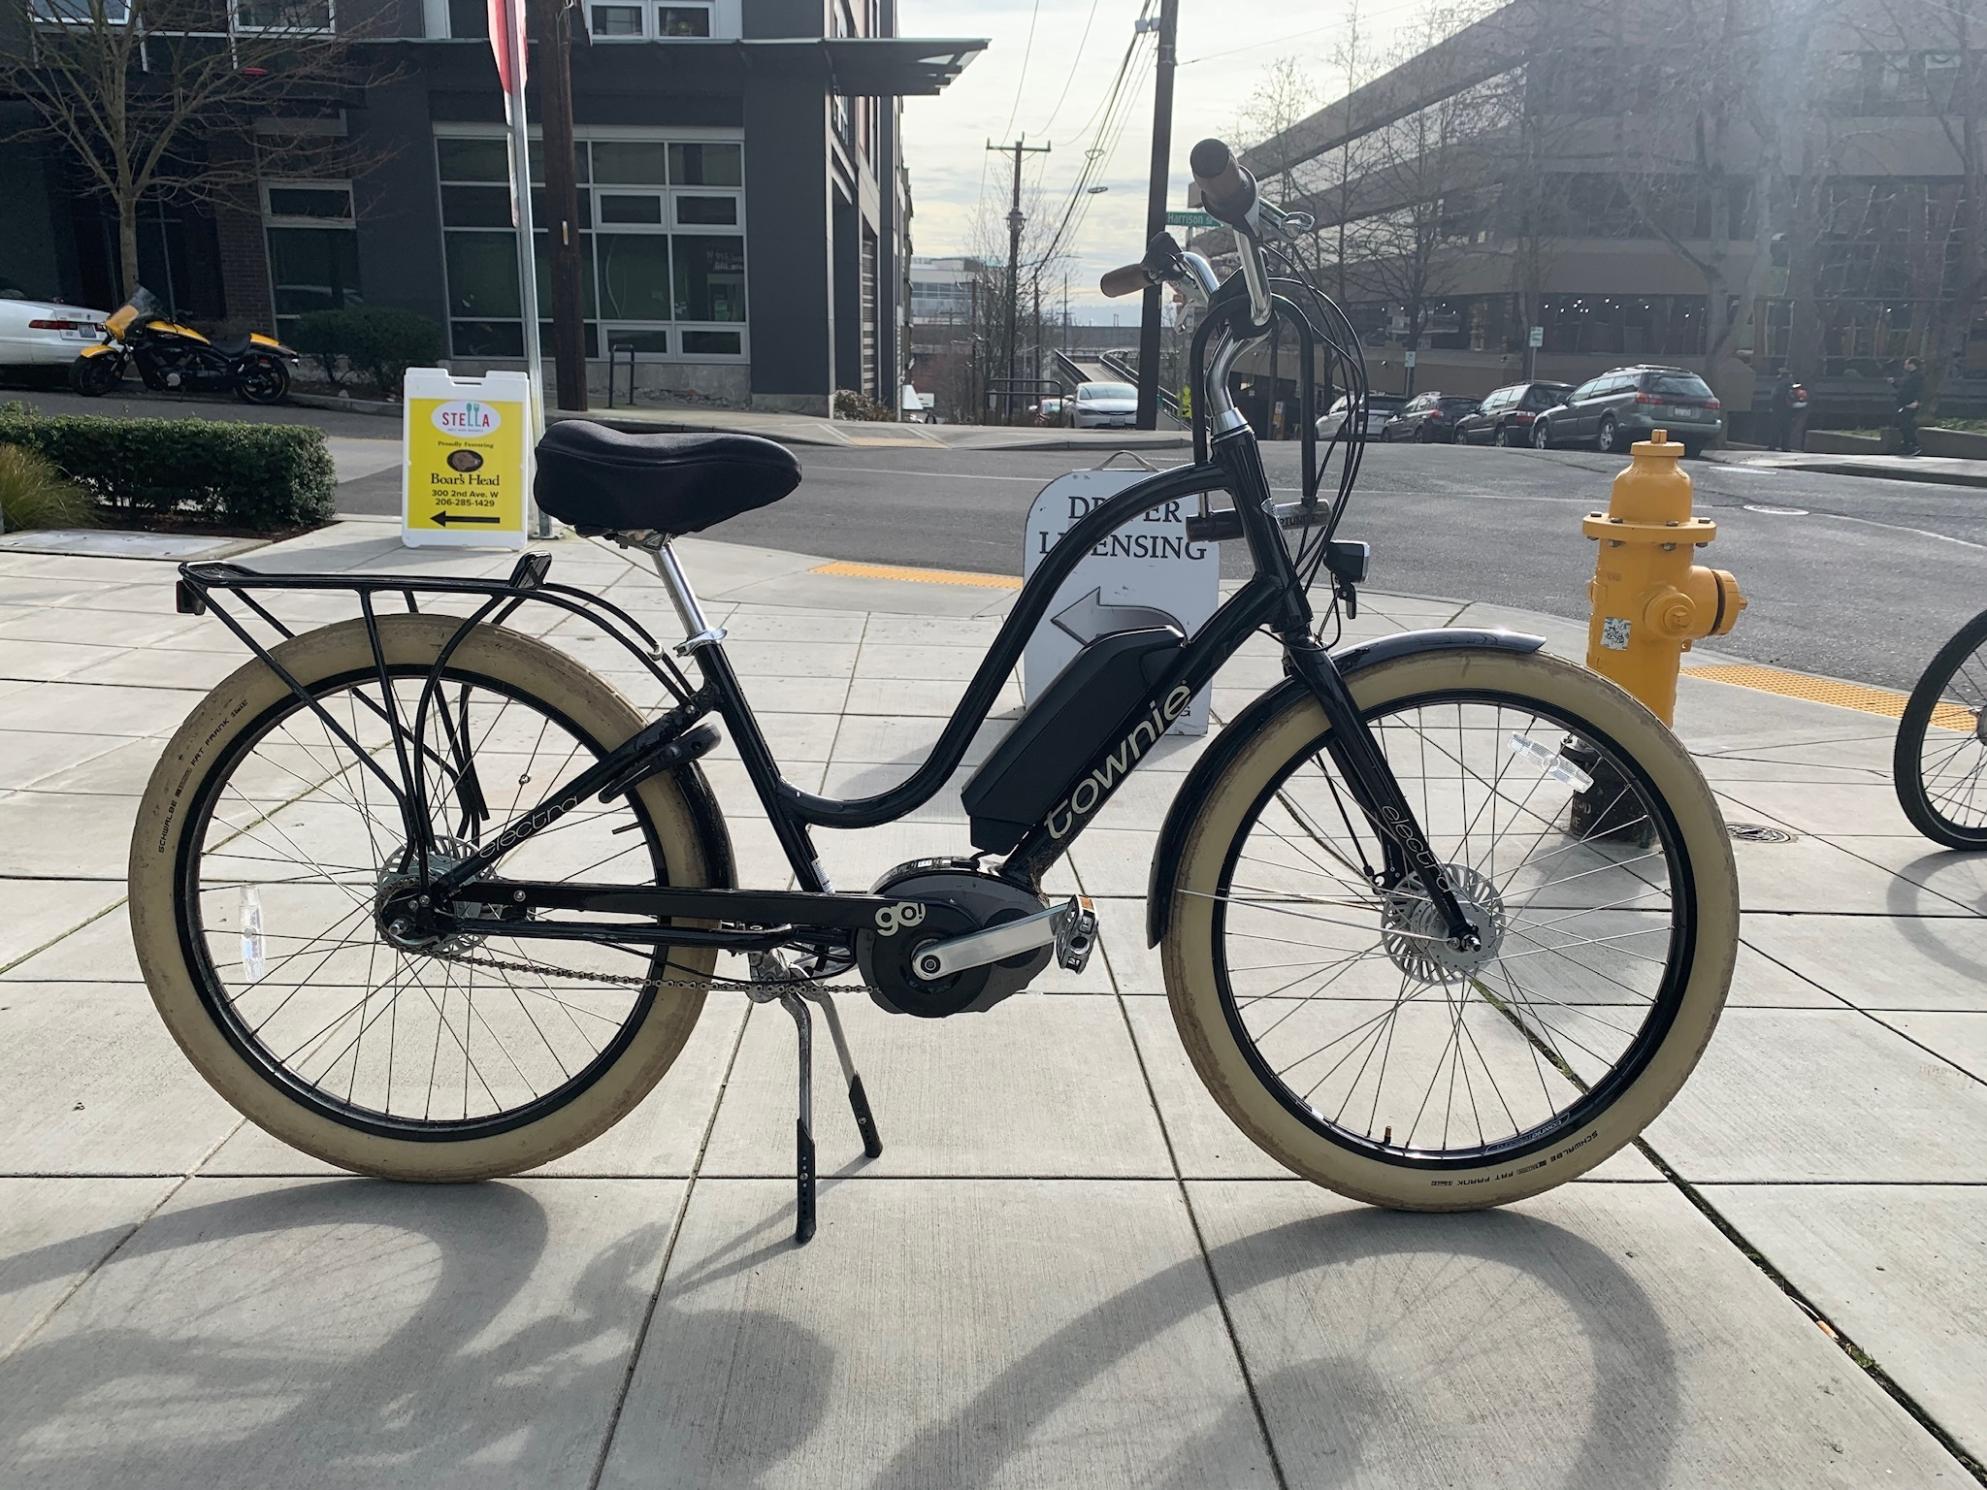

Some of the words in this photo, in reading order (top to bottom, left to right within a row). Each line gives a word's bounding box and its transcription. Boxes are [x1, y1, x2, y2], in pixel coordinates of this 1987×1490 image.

[1167, 212, 1203, 225] Harrison
[442, 403, 490, 427] STELLA
[431, 473, 465, 485] Boar's
[468, 474, 500, 486] Head
[431, 489, 449, 498] 300
[451, 490, 468, 498] 2nd
[469, 491, 488, 499] Ave.
[490, 491, 500, 499] W
[435, 498, 495, 507] 206-285-1429
[1068, 496, 1183, 523] DER
[1039, 531, 1207, 560] LENSING
[1044, 684, 1192, 840] townie
[480, 796, 578, 859] electra
[875, 901, 927, 937] go!
